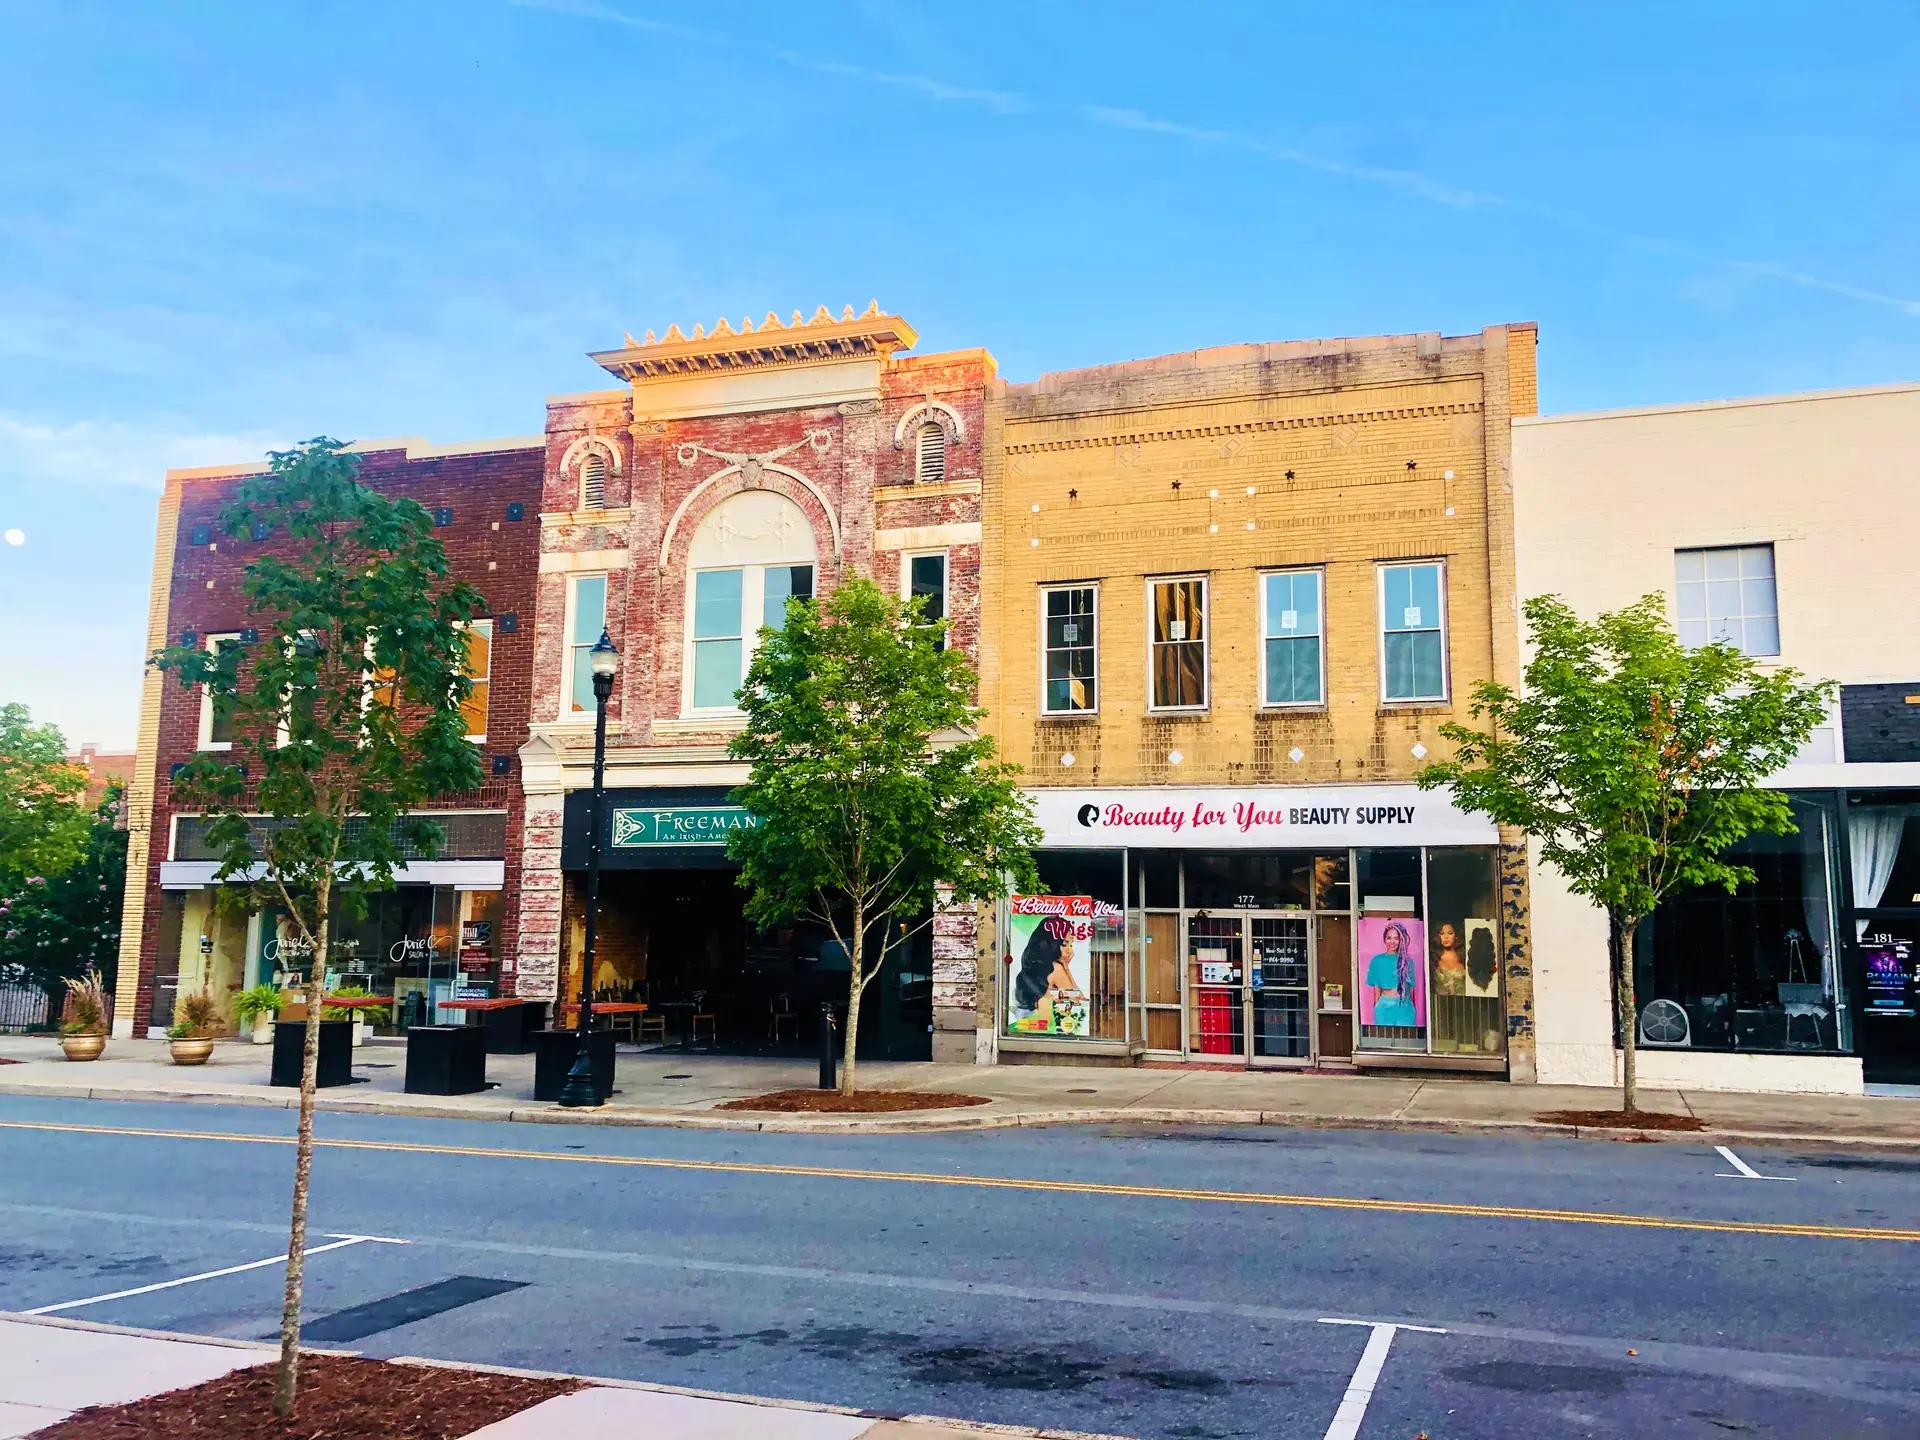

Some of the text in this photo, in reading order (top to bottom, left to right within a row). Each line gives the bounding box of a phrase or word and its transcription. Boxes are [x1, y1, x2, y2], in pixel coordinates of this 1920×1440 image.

[652, 812, 757, 841] FREEMAN
[1102, 802, 1415, 833] Beauty for You BEAUTY SUPPLY
[1012, 896, 1068, 918] Beauty
[1071, 899, 1090, 915] For
[1090, 900, 1118, 919] You
[1238, 895, 1255, 904] 177
[1044, 920, 1096, 941] Wigs
[1874, 933, 1893, 943] 181
